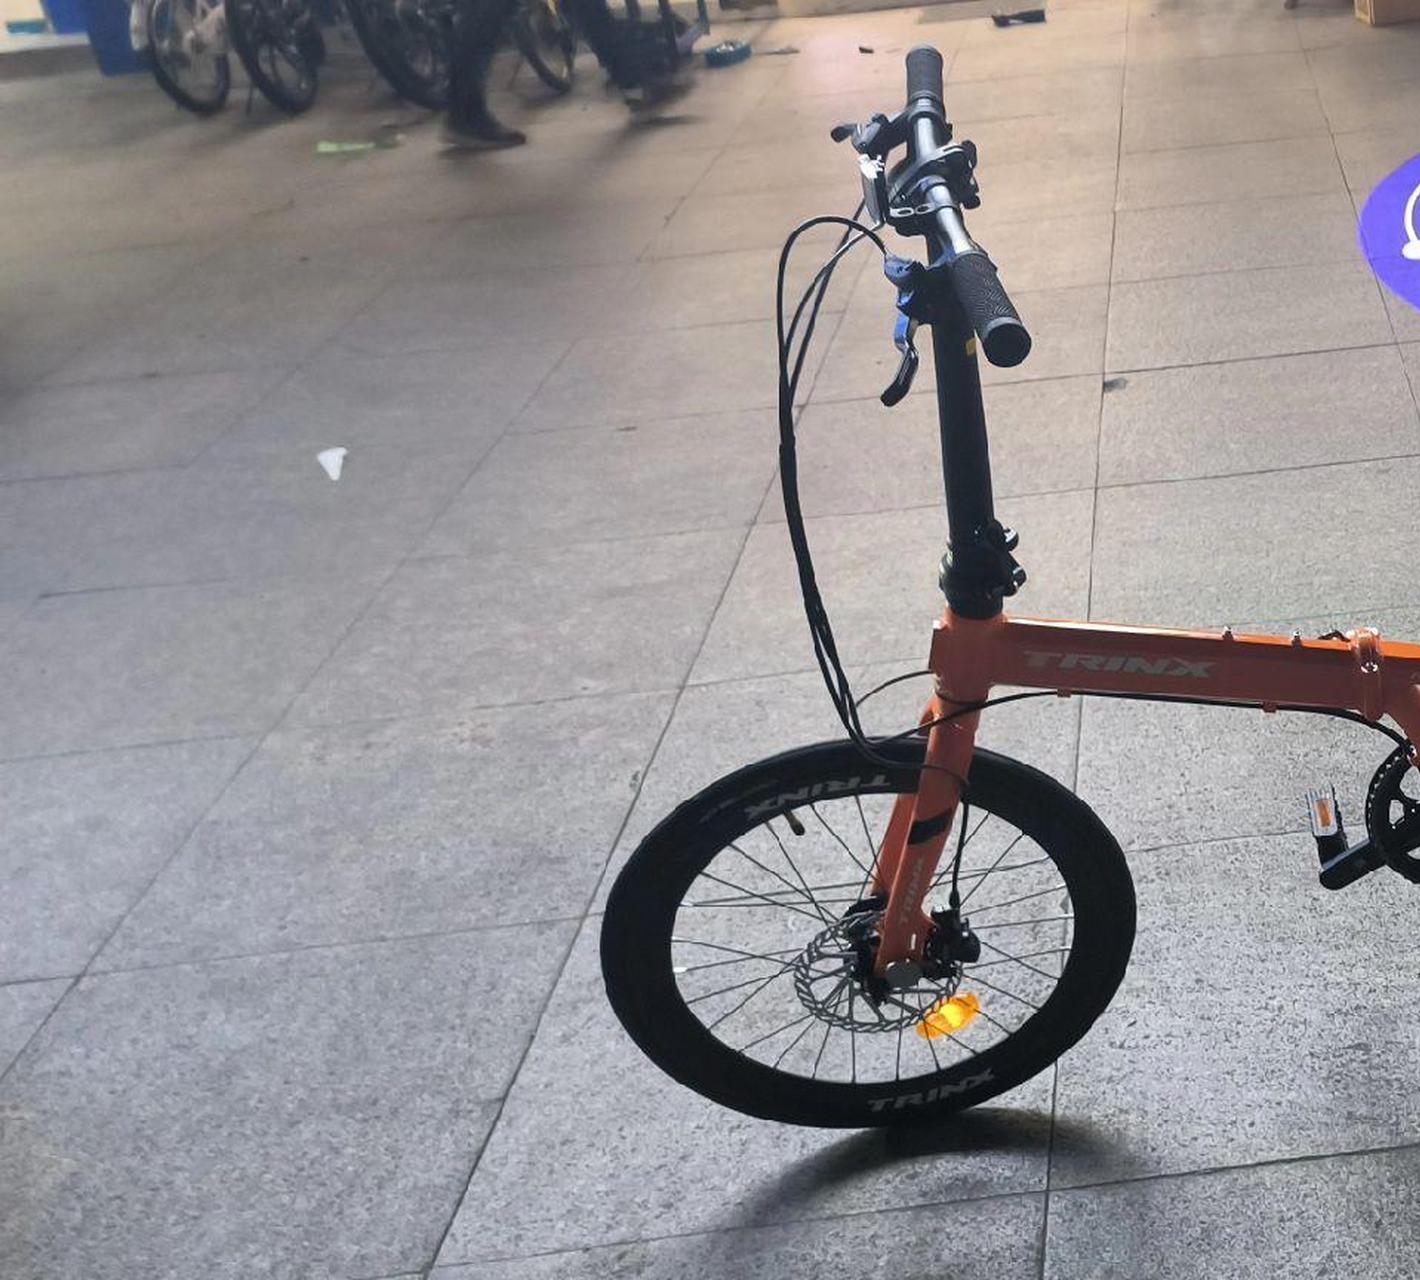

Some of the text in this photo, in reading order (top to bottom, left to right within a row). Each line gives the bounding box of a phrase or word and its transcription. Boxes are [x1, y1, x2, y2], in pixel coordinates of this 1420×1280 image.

[1023, 650, 1217, 678] TRINX
[744, 774, 892, 820] TRINX
[867, 1068, 996, 1113] TRINX
